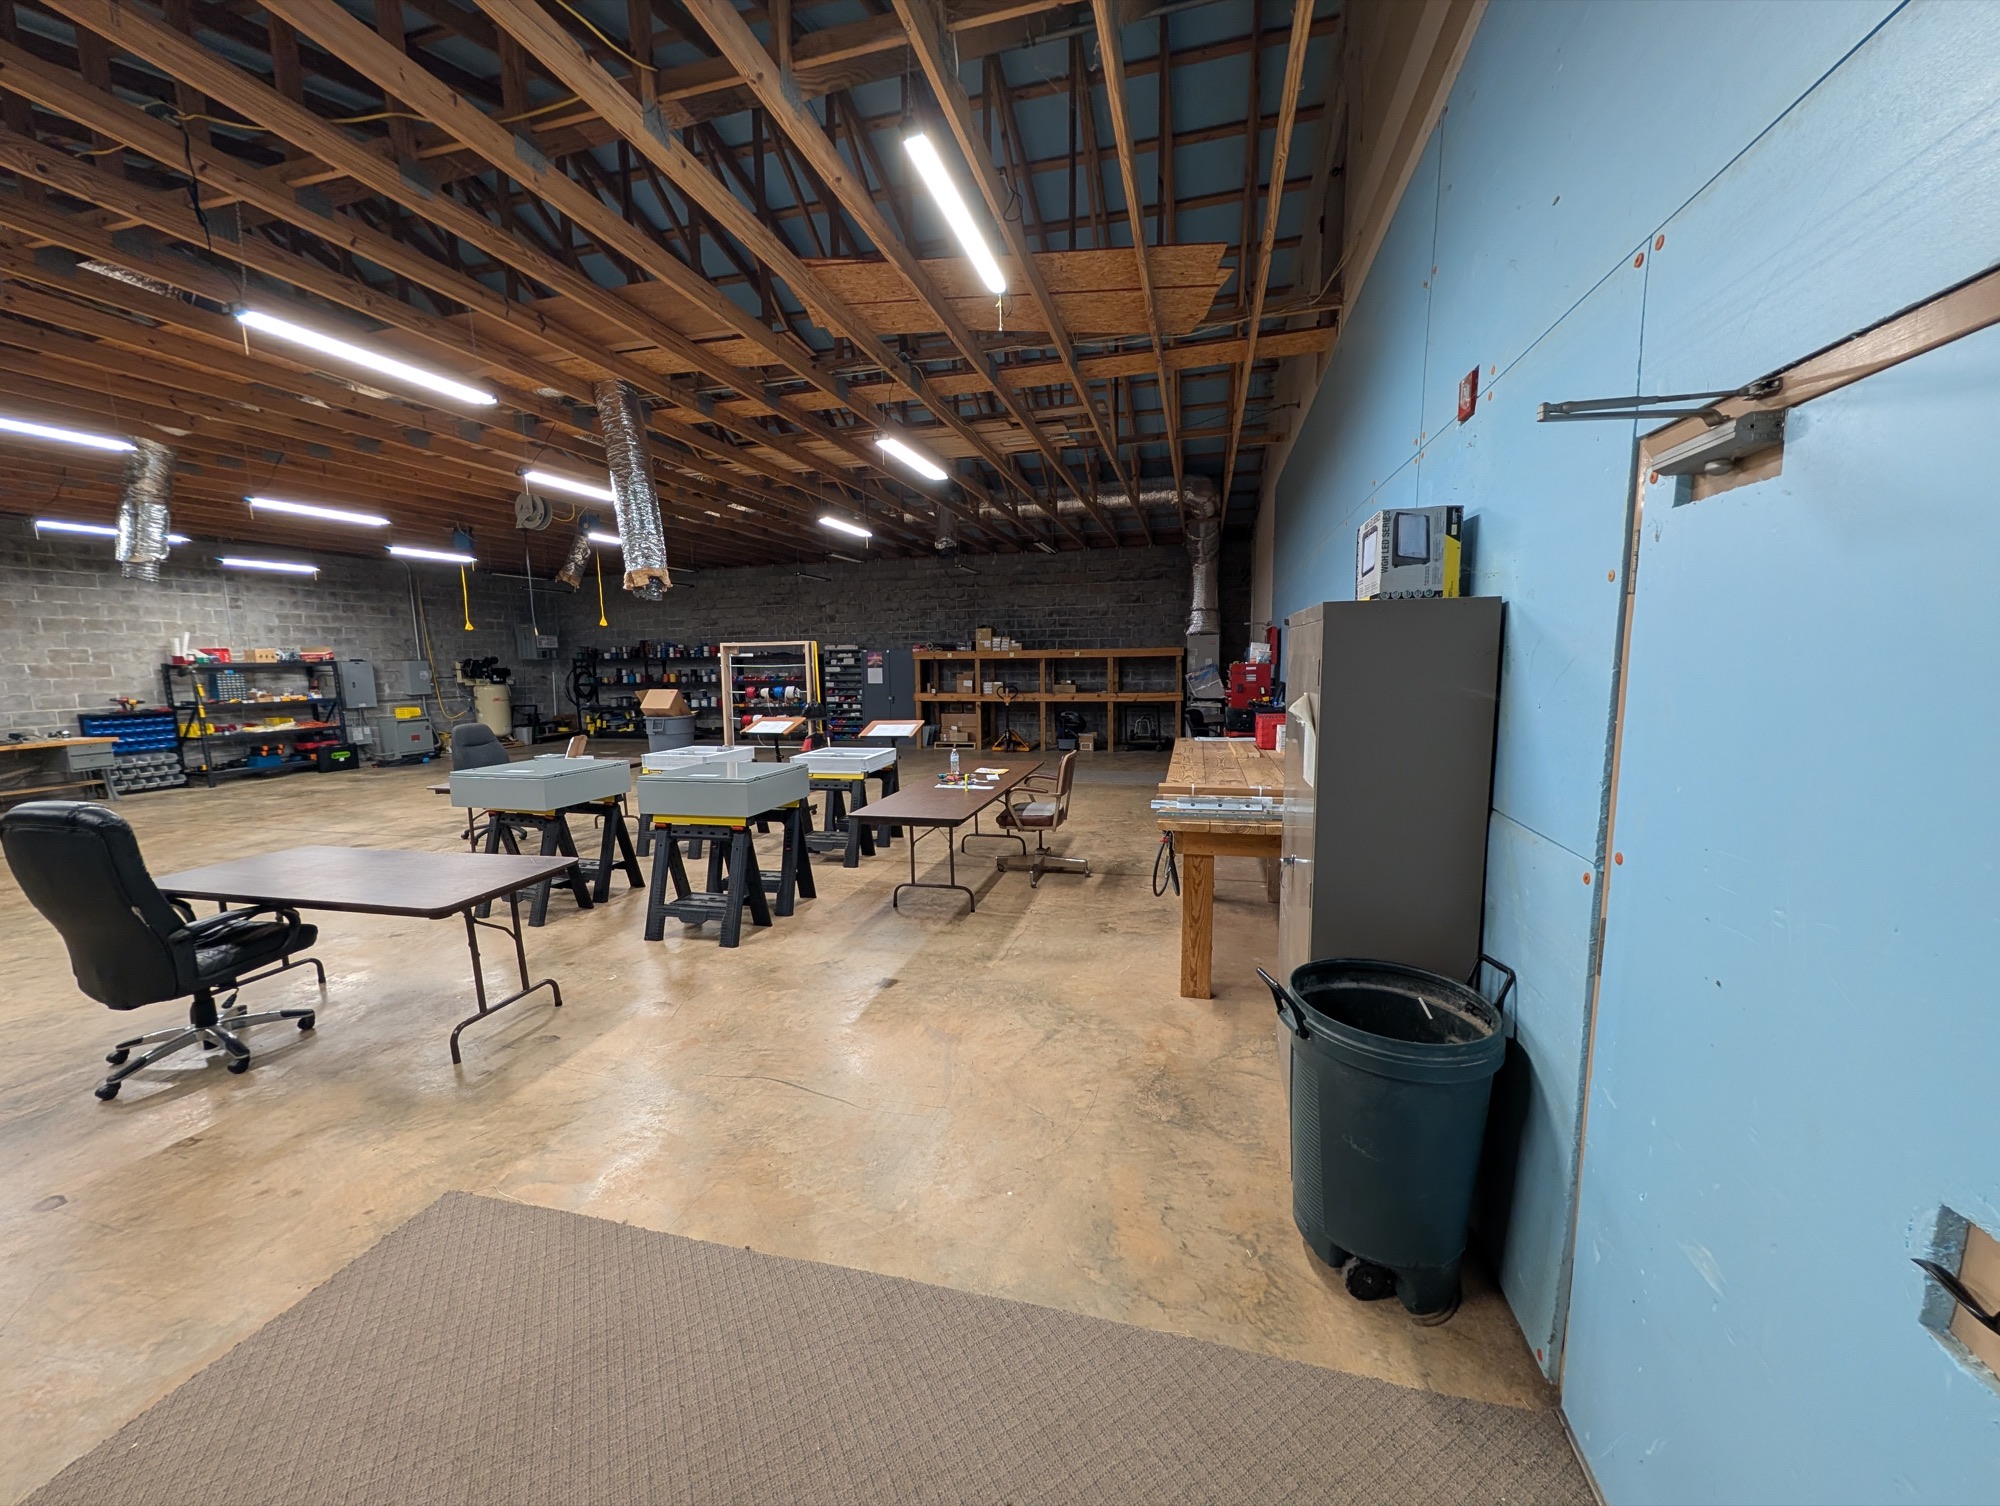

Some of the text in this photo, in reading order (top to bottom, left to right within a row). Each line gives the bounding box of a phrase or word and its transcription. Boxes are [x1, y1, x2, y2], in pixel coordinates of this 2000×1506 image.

[1381, 510, 1391, 574] WGH LED SERIES
